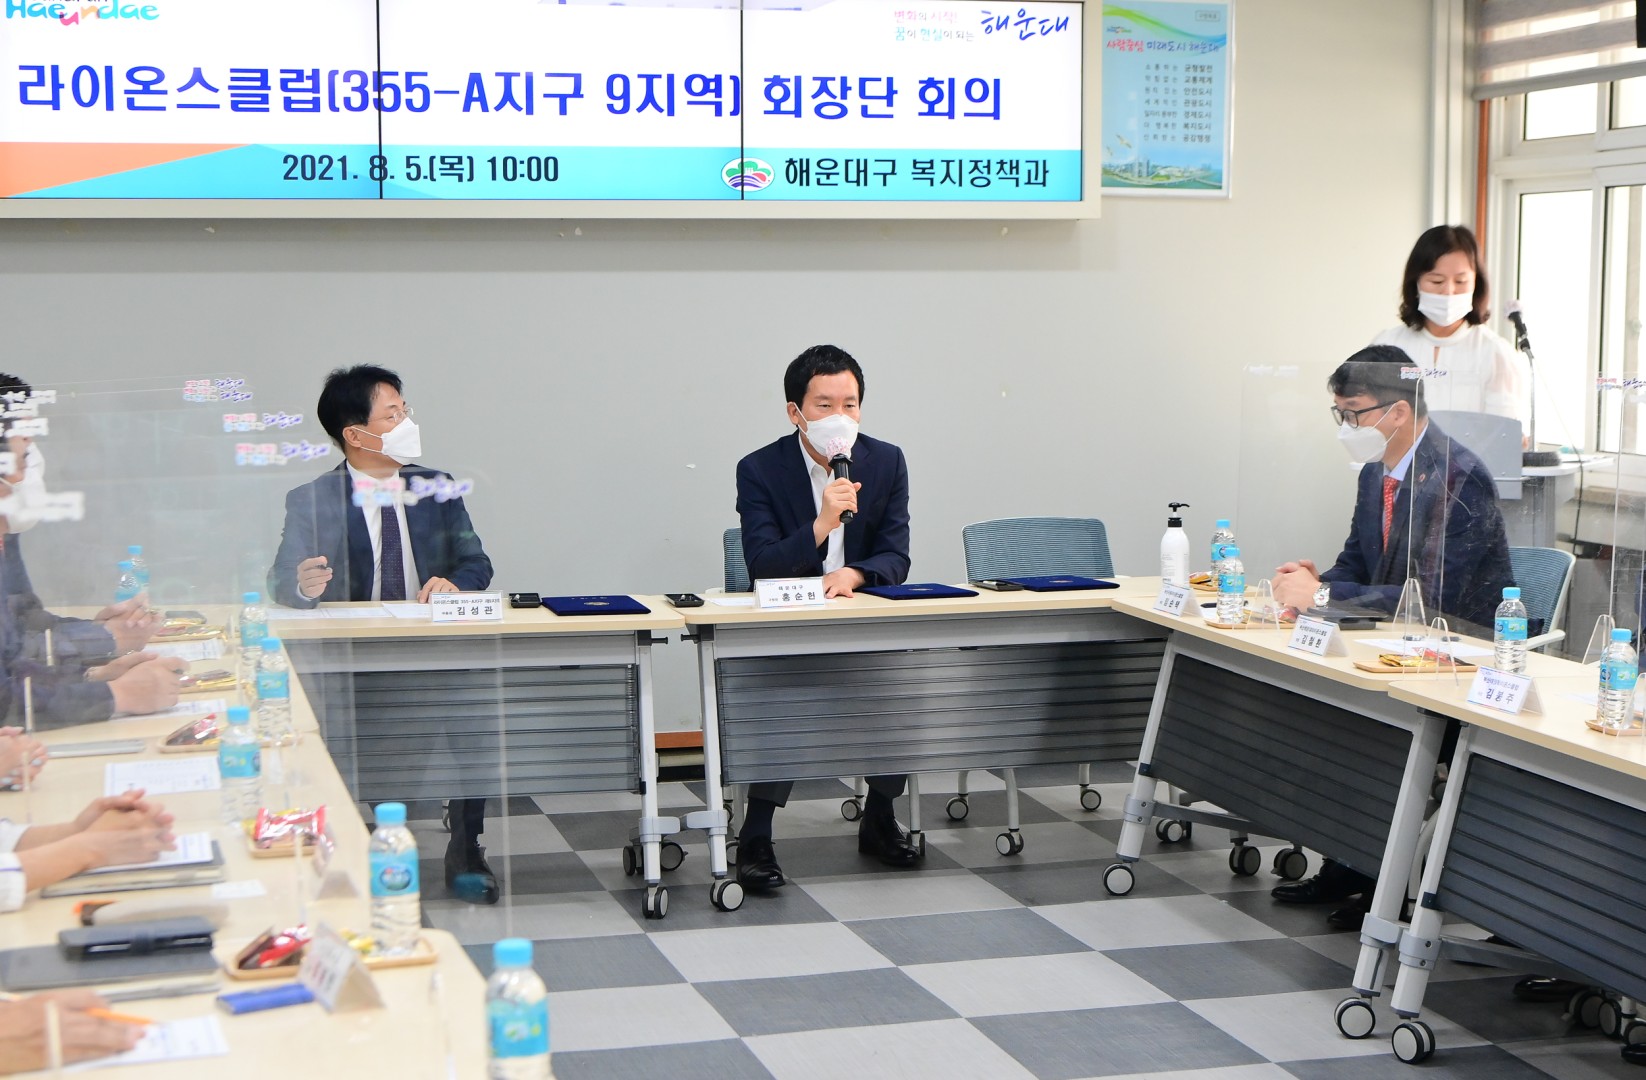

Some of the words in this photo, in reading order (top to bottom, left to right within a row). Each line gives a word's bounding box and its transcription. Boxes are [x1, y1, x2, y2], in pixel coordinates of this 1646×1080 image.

[6, 0, 160, 26] Haeundae
[980, 8, 1069, 41] 해운대
[1106, 38, 1144, 53] 사람중심
[1147, 39, 1186, 52] 미래도시
[18, 64, 586, 116] 라이온스클럽(355-A지구
[605, 73, 741, 118] 9지역)
[762, 75, 899, 120] 회장단
[917, 77, 1002, 121] 회의
[282, 154, 359, 182] 2021.
[487, 155, 560, 183] 10:00
[784, 157, 898, 188] 해운대구
[910, 157, 1050, 189] 복지정책과
[457, 606, 493, 616] 김성관
